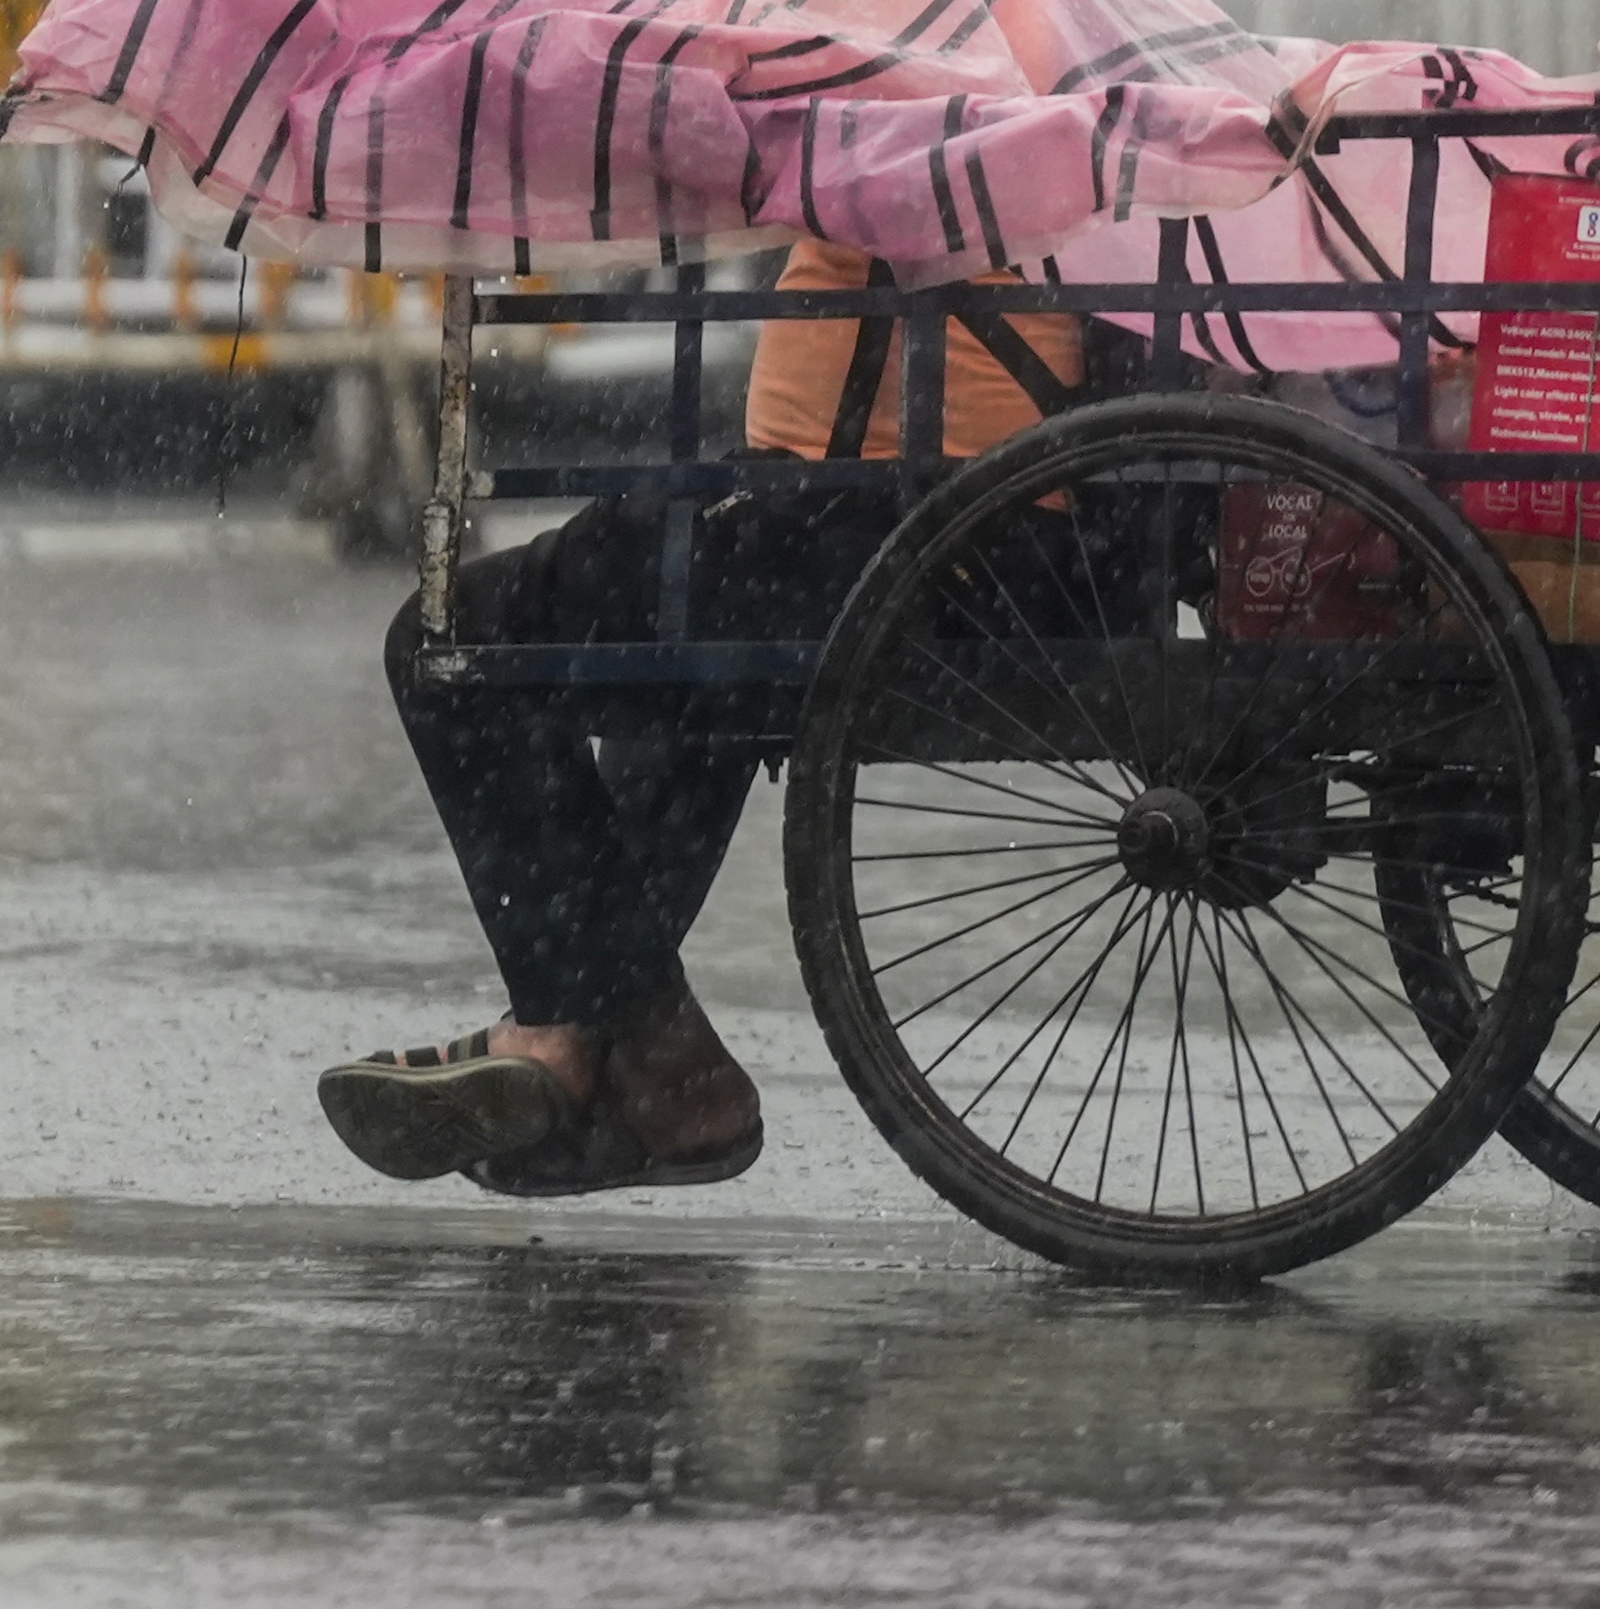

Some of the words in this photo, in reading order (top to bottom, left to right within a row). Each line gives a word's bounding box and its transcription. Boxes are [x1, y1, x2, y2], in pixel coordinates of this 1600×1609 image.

[1498, 344, 1533, 356] Control
[1494, 385, 1519, 399] Light
[1519, 390, 1544, 399] color
[1267, 494, 1314, 511] VOCAL
